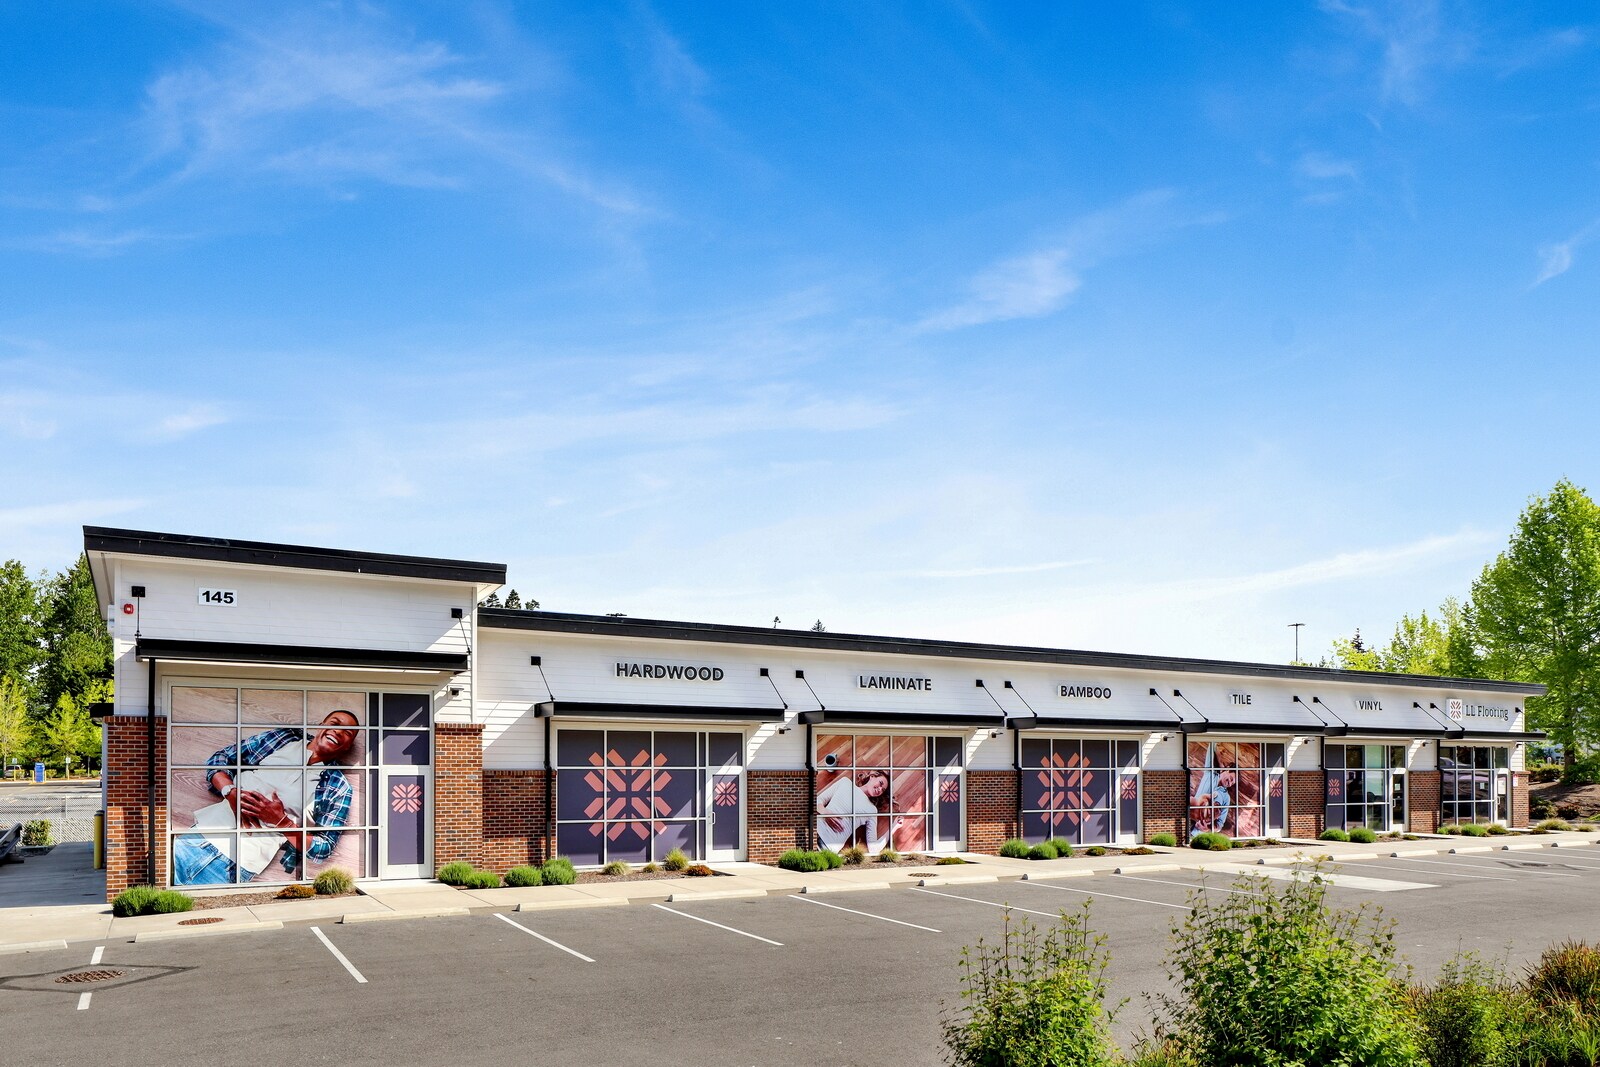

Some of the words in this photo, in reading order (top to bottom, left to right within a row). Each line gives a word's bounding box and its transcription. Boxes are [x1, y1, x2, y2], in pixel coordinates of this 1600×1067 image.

[202, 591, 234, 604] 145
[616, 663, 724, 681] HARDWOOD
[859, 676, 932, 690] LAMINATE
[1060, 686, 1111, 699] BAMBOO
[1232, 694, 1251, 704] TILE
[1359, 701, 1382, 710] VINYL
[1465, 705, 1475, 716] LL
[1477, 706, 1508, 721] Flooring
